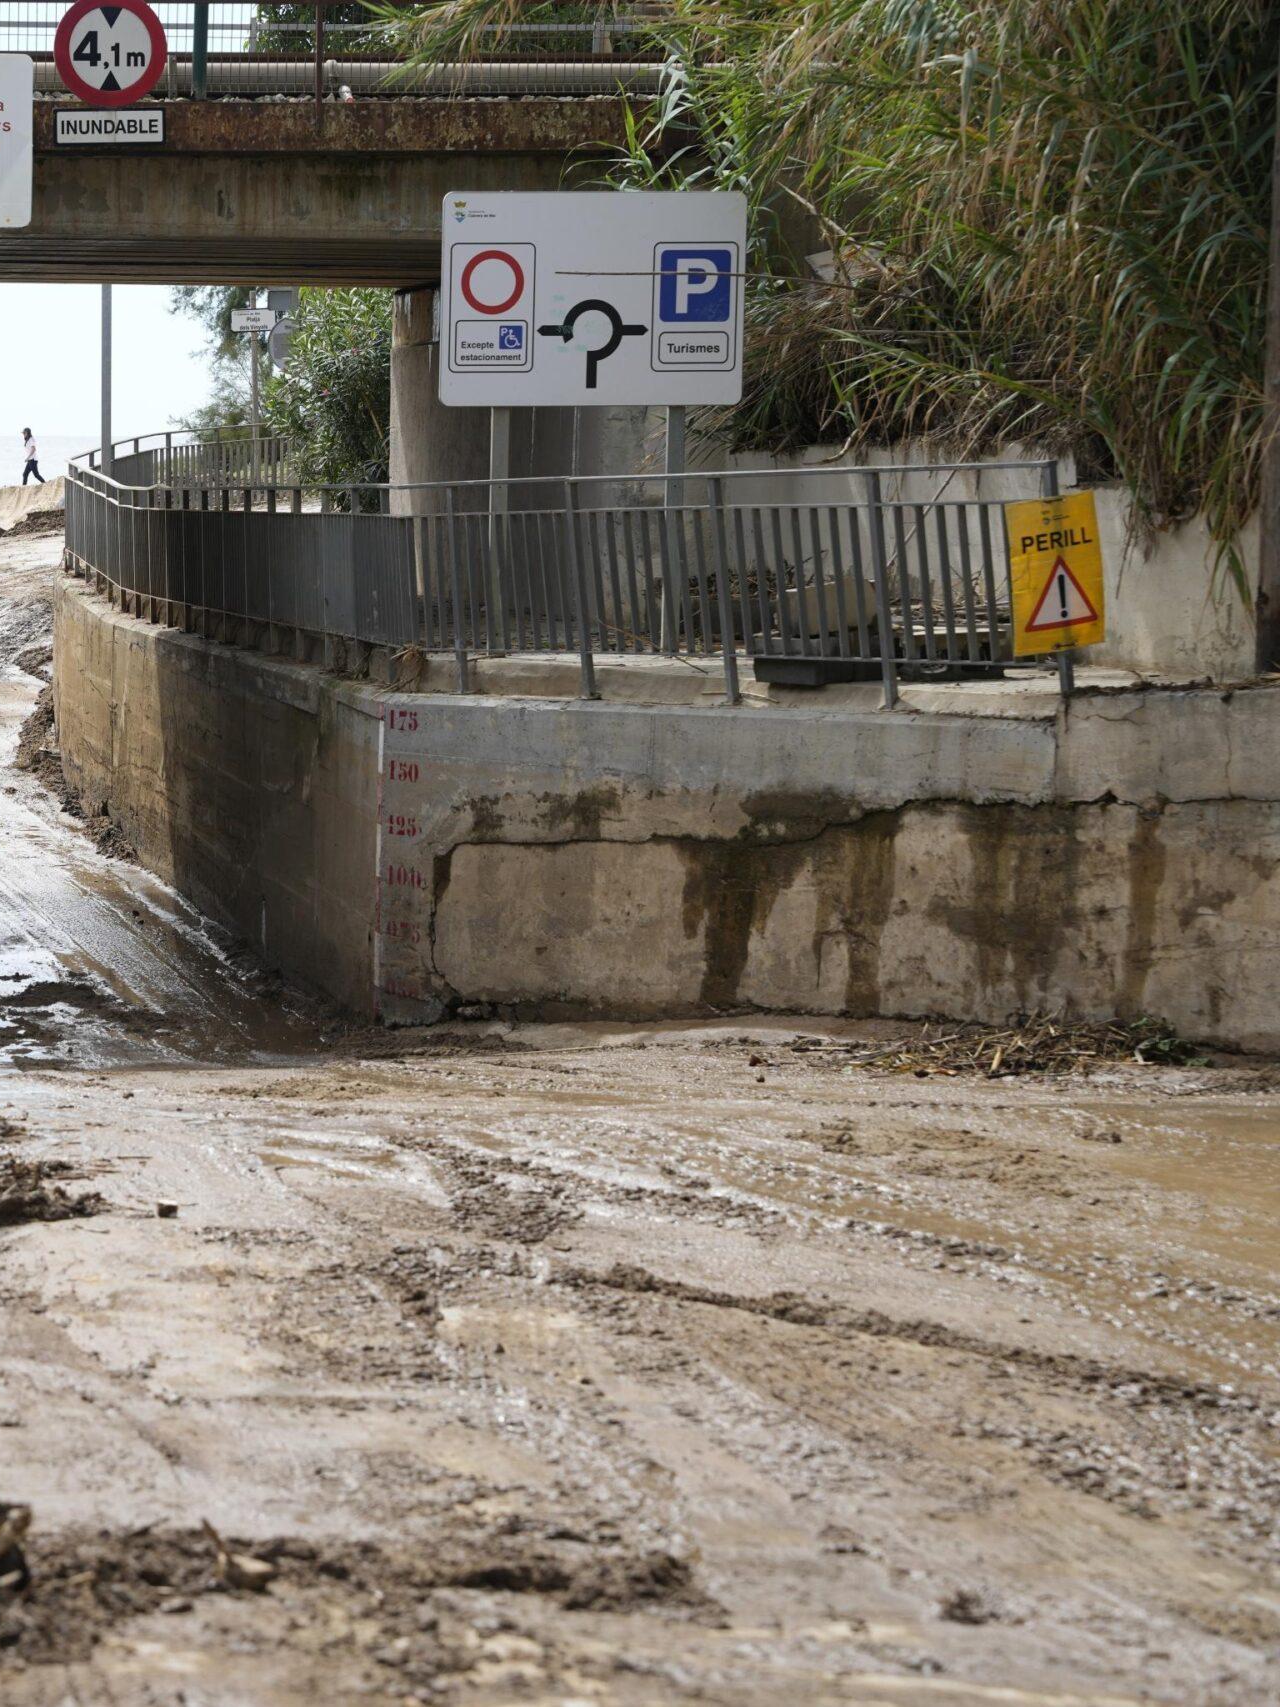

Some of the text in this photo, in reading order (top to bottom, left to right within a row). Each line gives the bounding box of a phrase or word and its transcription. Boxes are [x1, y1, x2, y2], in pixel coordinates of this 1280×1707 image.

[61, 119, 159, 135] INUNDABLE
[675, 258, 718, 314] P
[461, 341, 495, 350] Excepte
[667, 343, 720, 353] Turismes
[1021, 526, 1093, 554] PERILL
[389, 709, 419, 731] 175
[389, 760, 419, 782] 150
